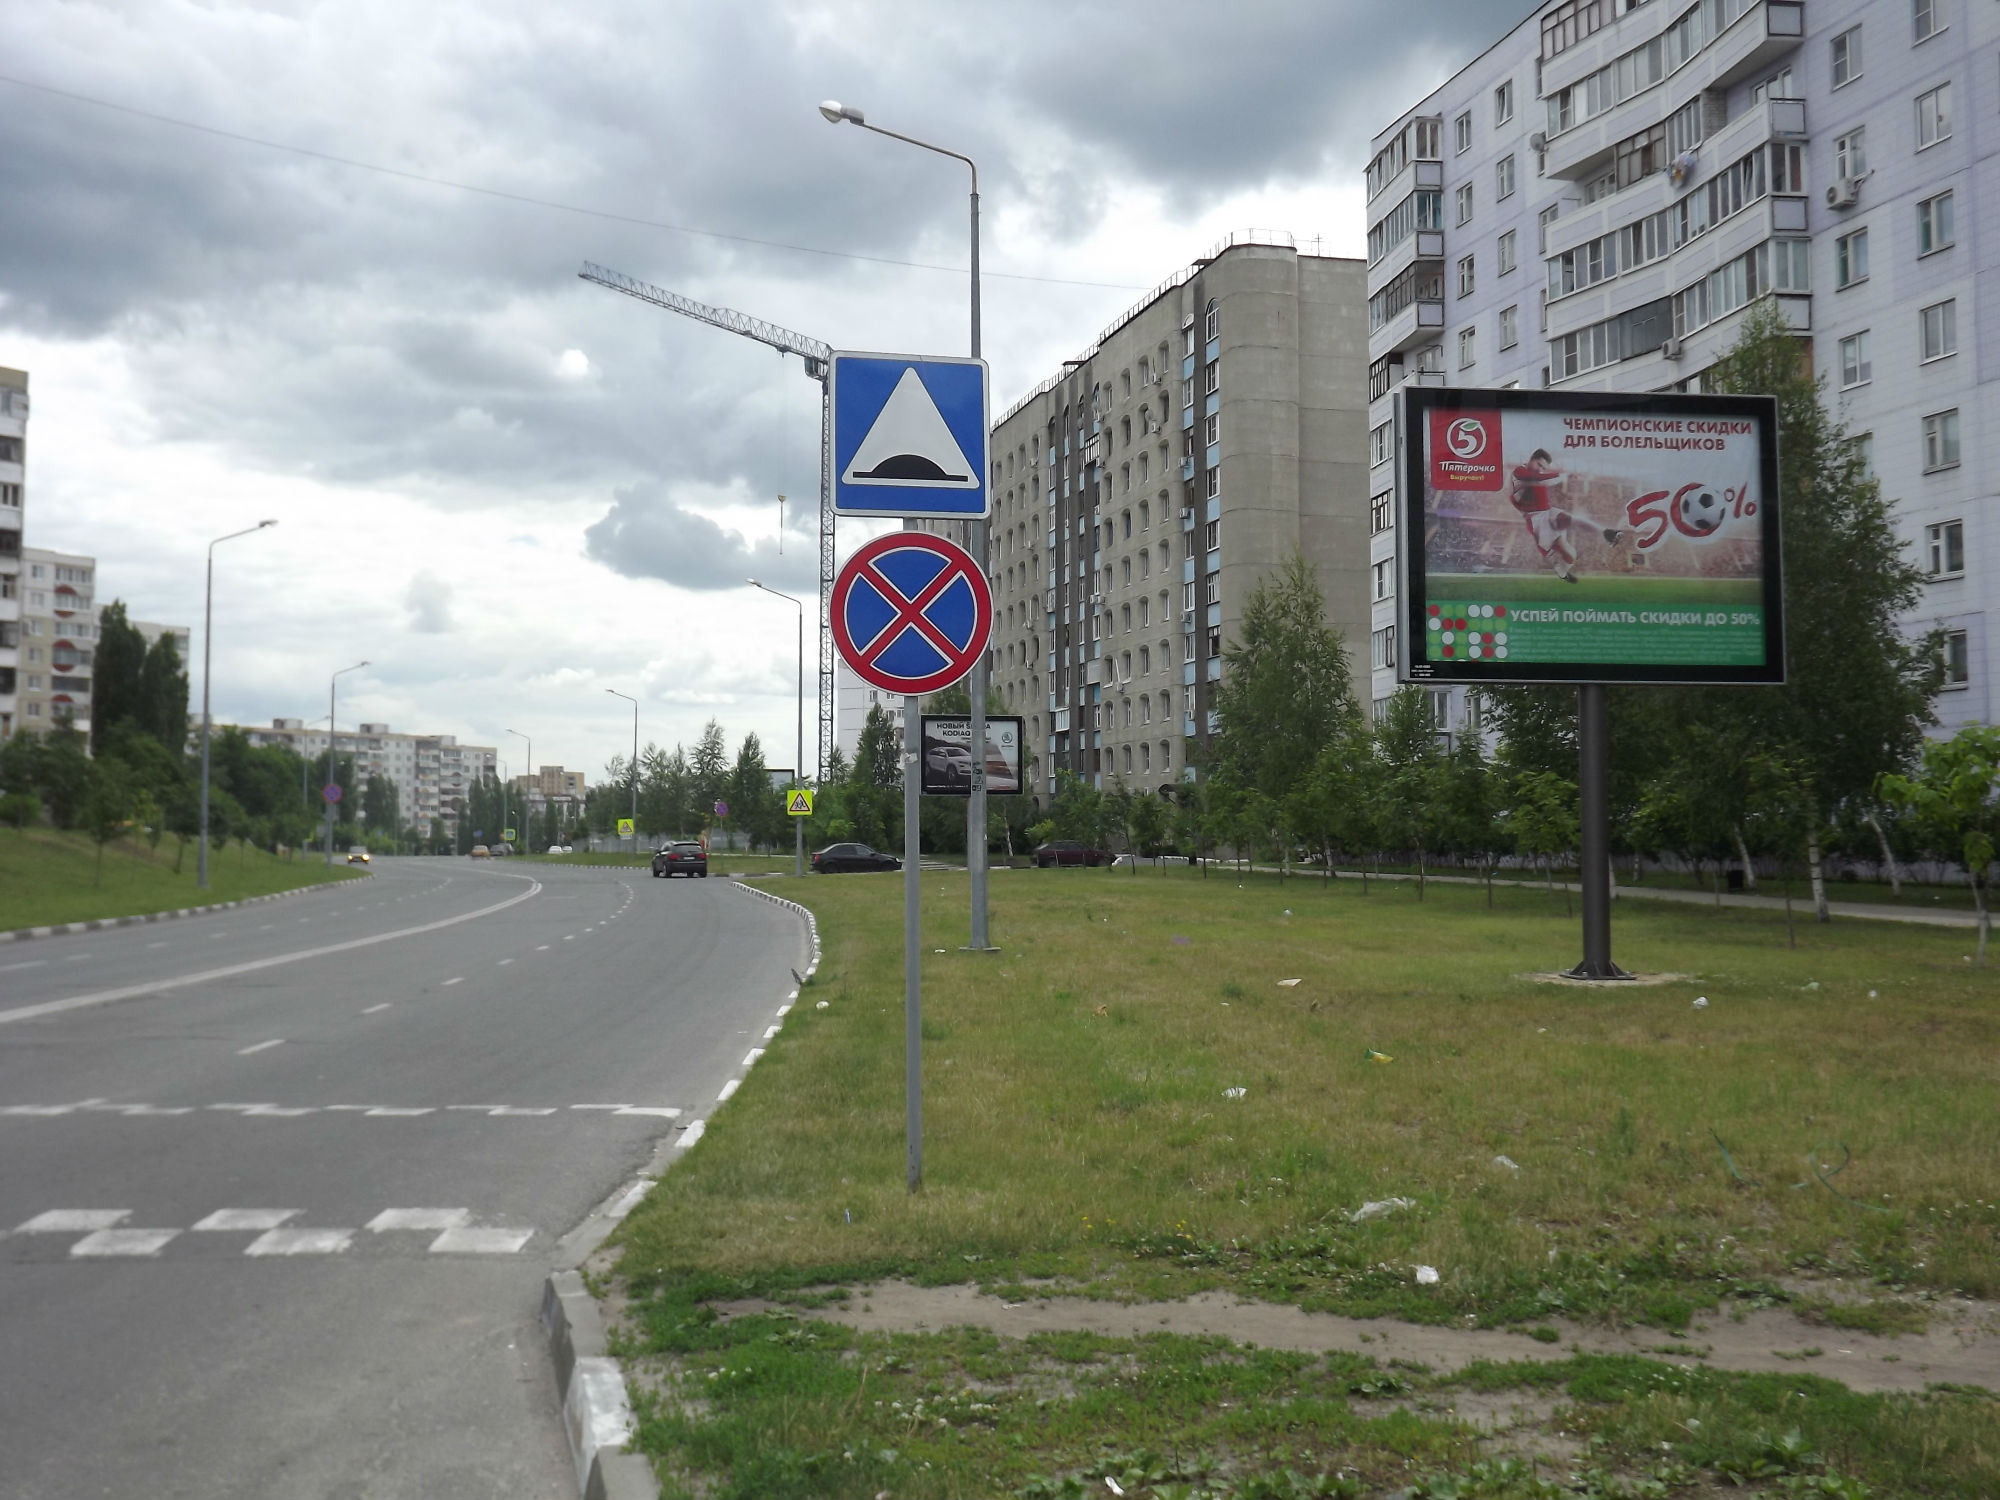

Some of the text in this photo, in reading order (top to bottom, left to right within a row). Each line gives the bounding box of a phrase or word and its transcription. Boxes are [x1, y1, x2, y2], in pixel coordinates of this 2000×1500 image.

[1563, 418, 1753, 436] ЧЕМПИОНСКИЕ СКИДКИ
[1563, 434, 1726, 452] ДЛЯ БОЛЕЛЬЩИКОВ
[1438, 460, 1497, 474] Пятерочка
[1626, 482, 1758, 549] 50%
[1510, 607, 1761, 627] УСПЕЙ ПОЙМАТЬ СКИДКИ ДО 50%
[936, 721, 965, 730] НОВЫЙ
